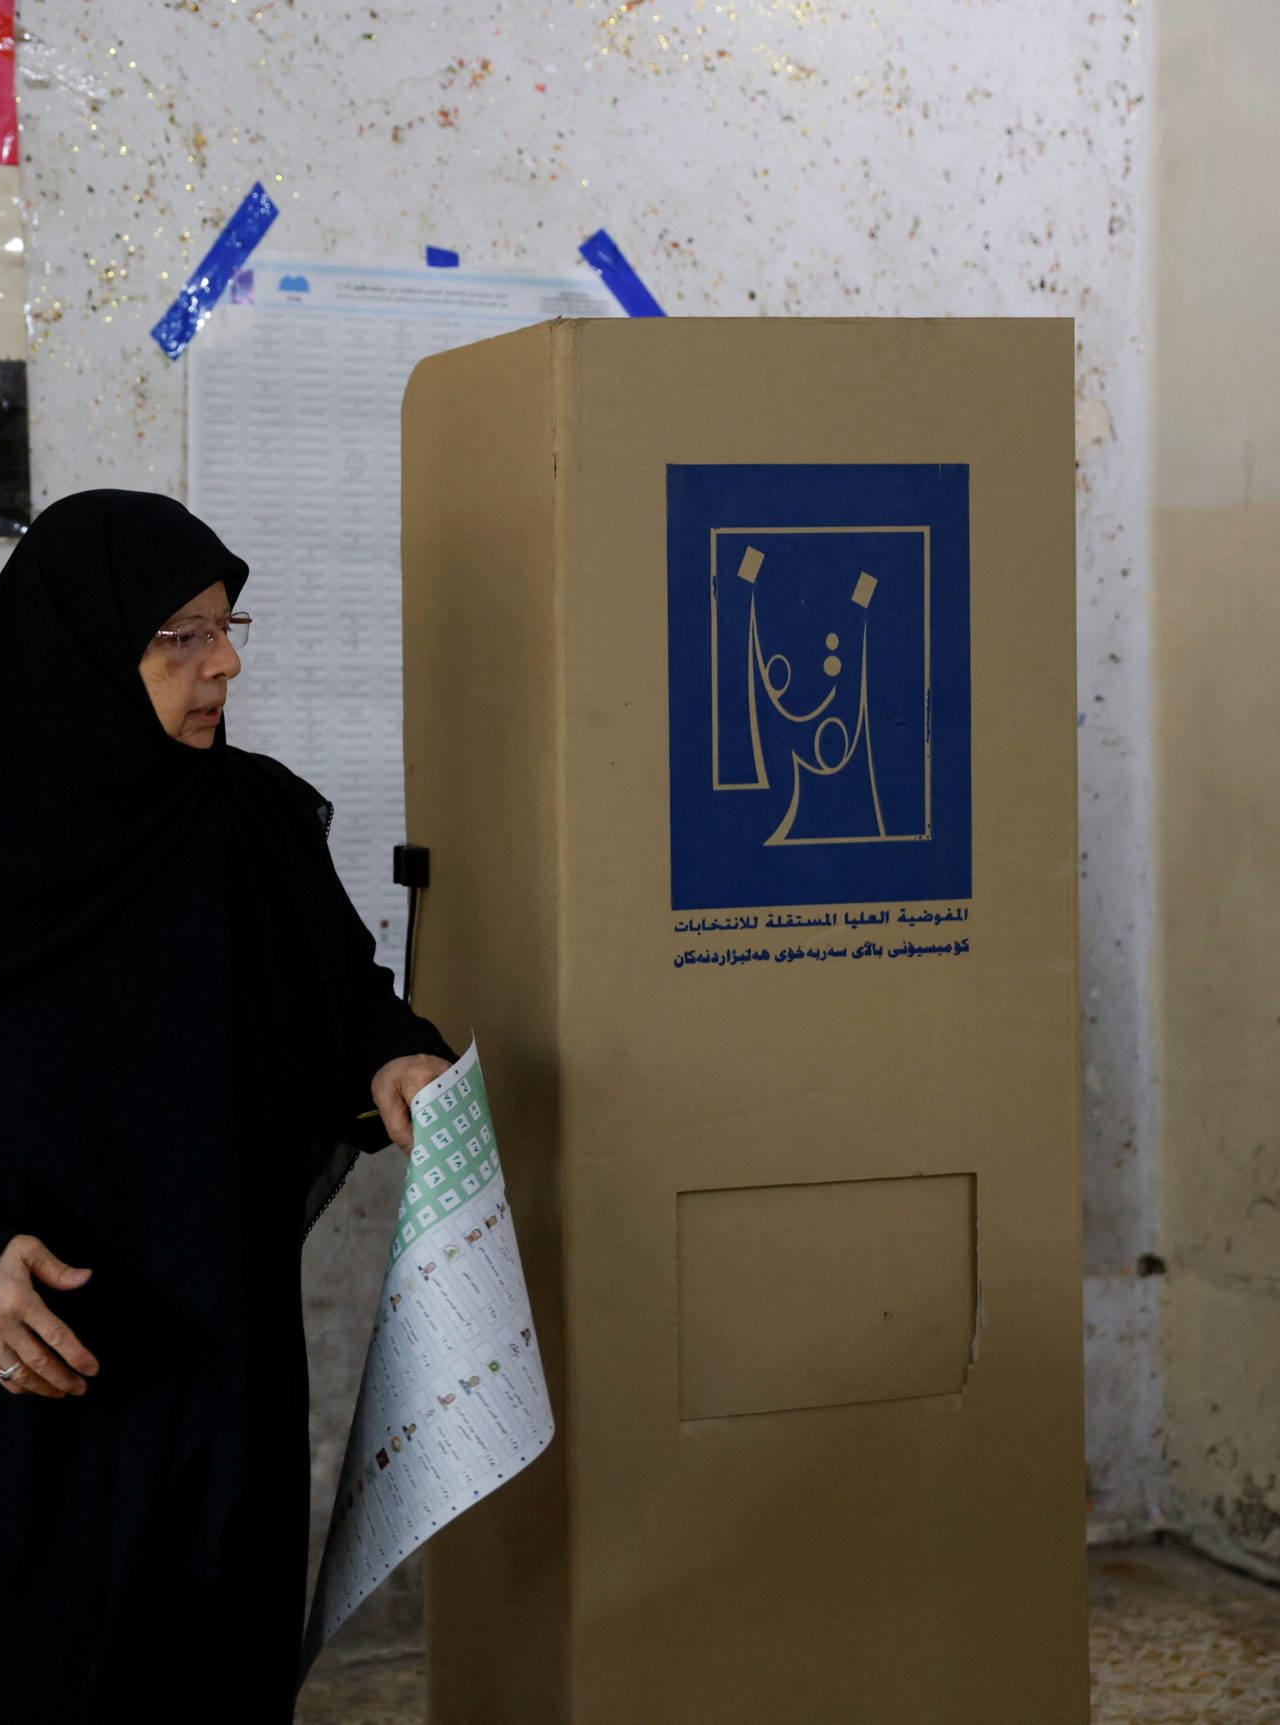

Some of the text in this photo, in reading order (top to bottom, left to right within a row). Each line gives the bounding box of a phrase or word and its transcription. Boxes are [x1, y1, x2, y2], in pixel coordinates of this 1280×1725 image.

[673, 907, 969, 936] المفوضية العليا المستقلة للانتخابات
